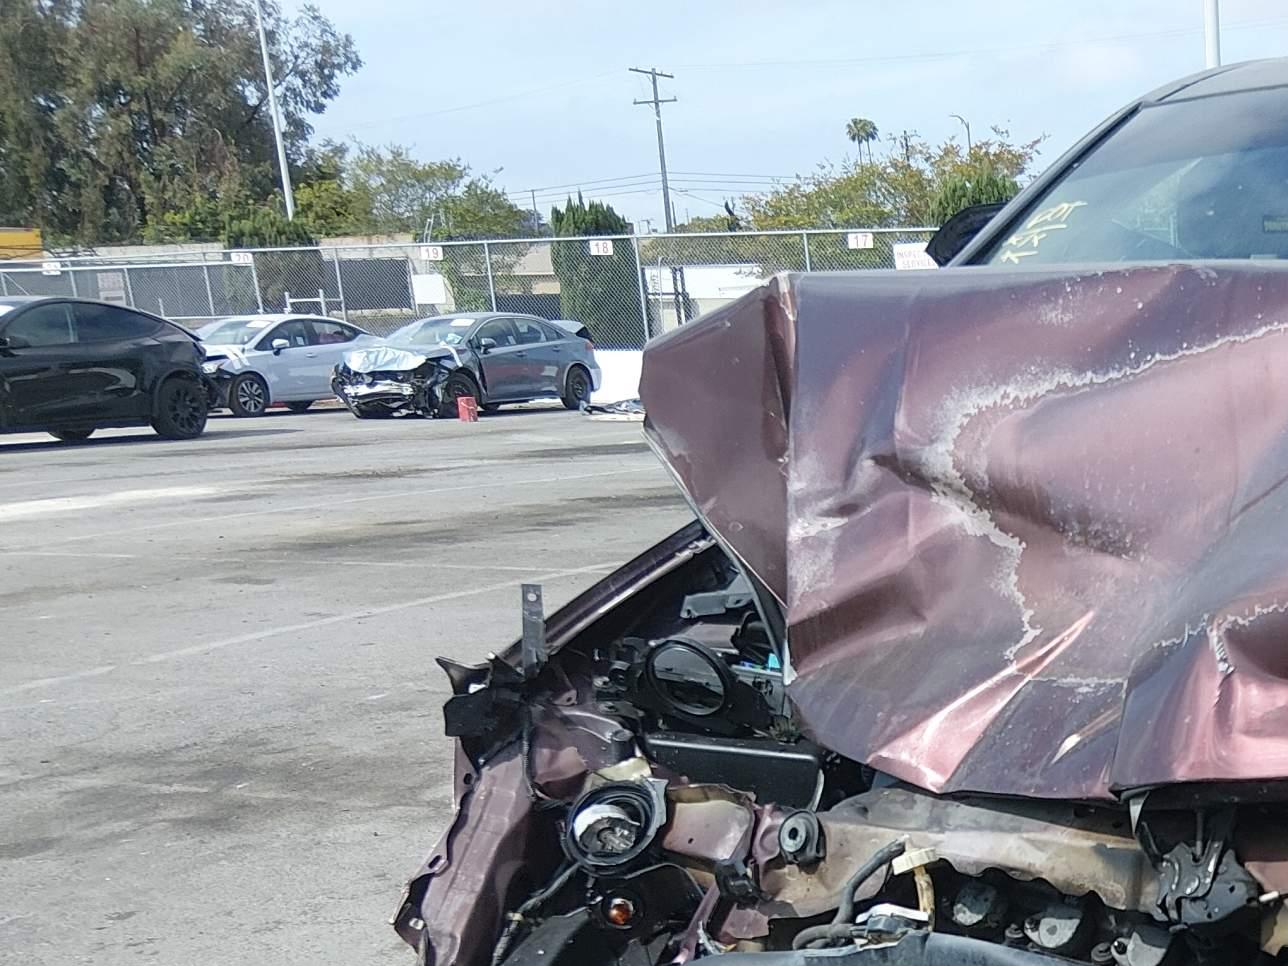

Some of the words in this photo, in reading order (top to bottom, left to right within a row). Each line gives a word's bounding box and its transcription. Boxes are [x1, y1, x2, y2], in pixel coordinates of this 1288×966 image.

[853, 234, 869, 247] 17
[425, 247, 439, 259] 19
[595, 241, 610, 255] 18
